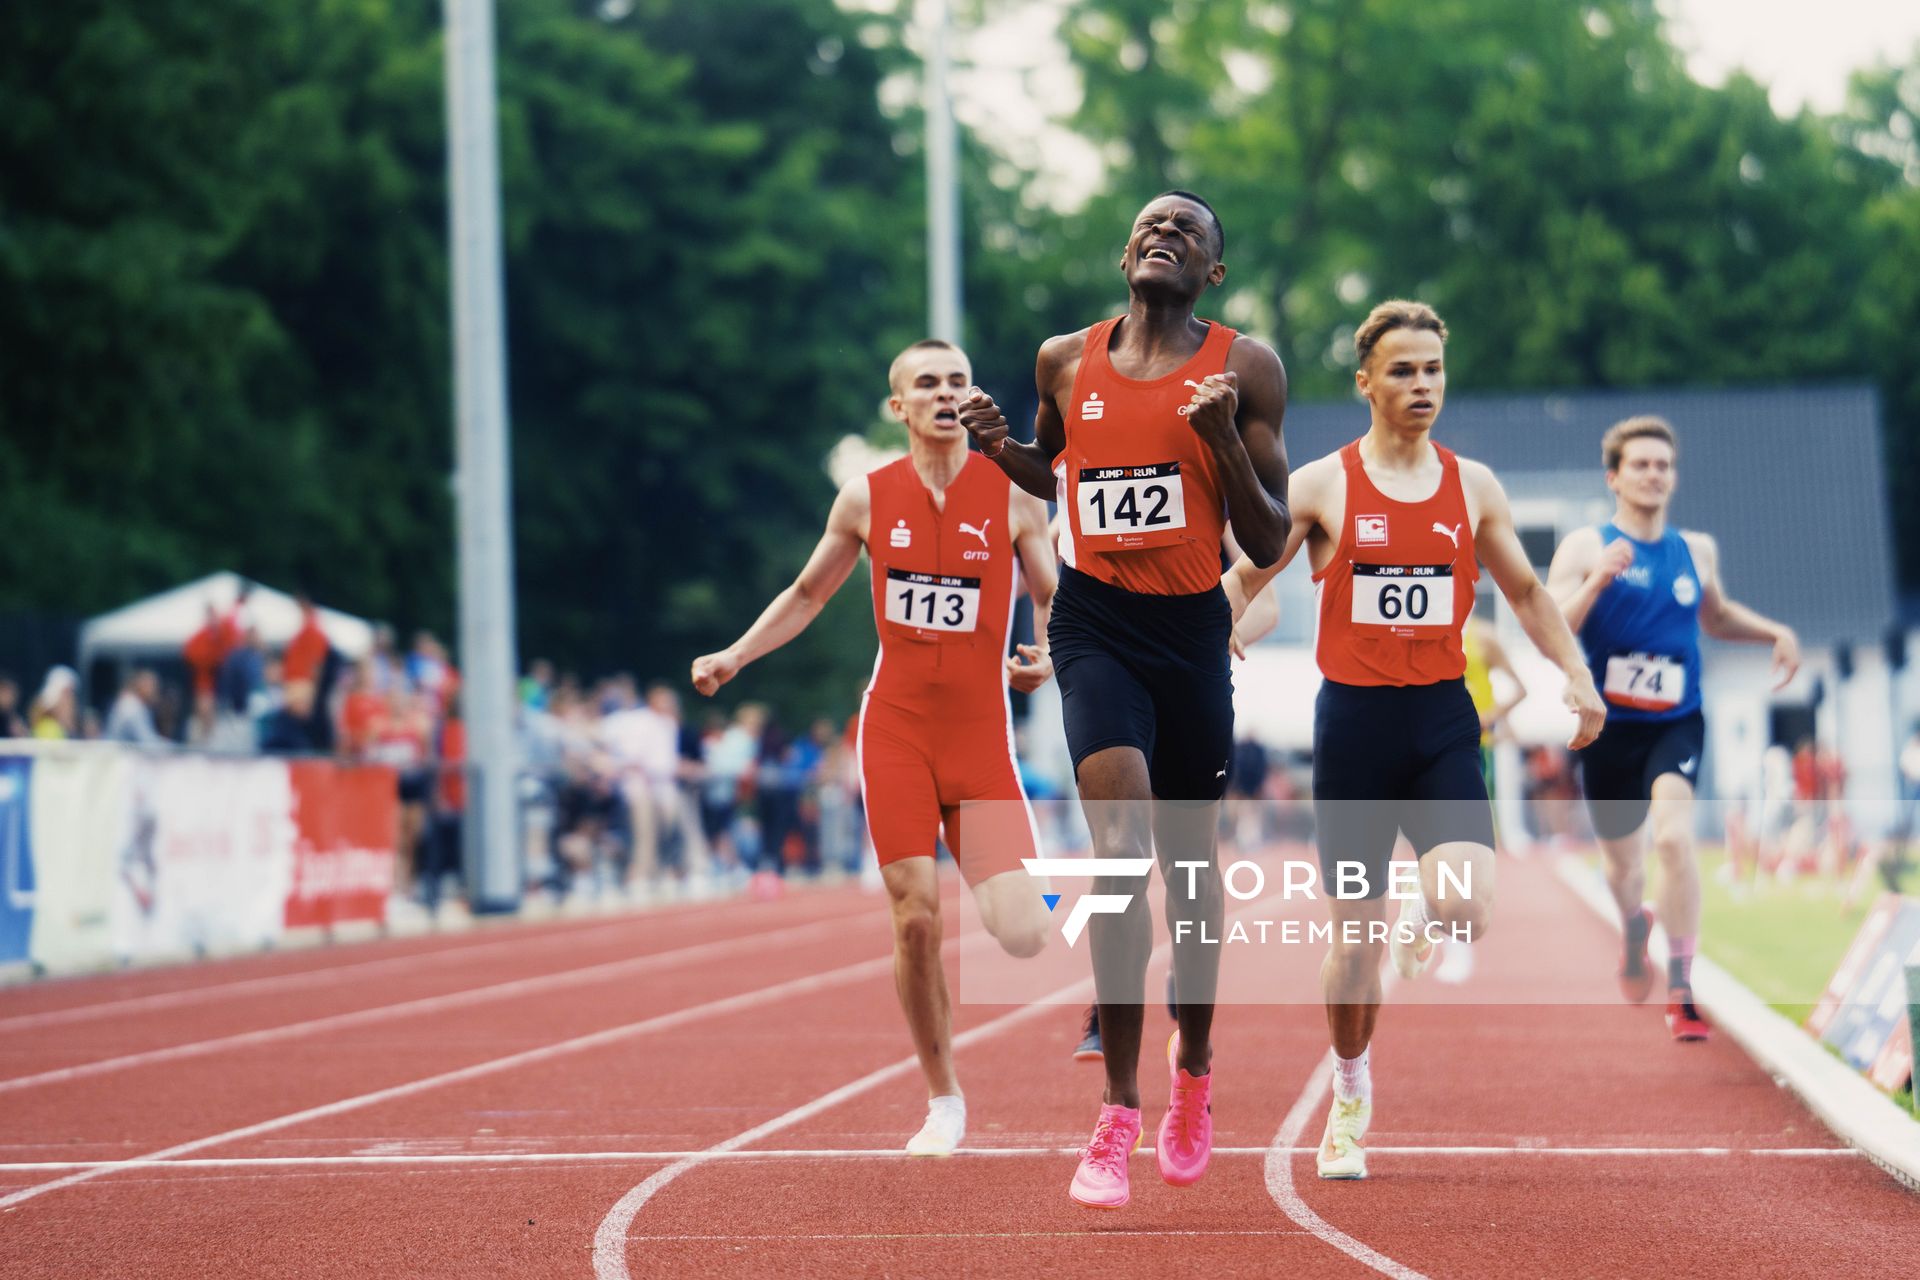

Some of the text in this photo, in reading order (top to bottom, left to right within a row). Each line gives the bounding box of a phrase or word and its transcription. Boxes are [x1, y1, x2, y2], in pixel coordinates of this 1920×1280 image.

[1096, 467, 1157, 479] JUMP N RUN
[1090, 485, 1171, 529] 142
[907, 573, 933, 583] JUMP
[941, 577, 962, 586] RUN
[1375, 567, 1434, 575] JUMP N RUN
[899, 588, 964, 626] 113
[1378, 584, 1428, 620] 60
[1627, 664, 1663, 694] 74
